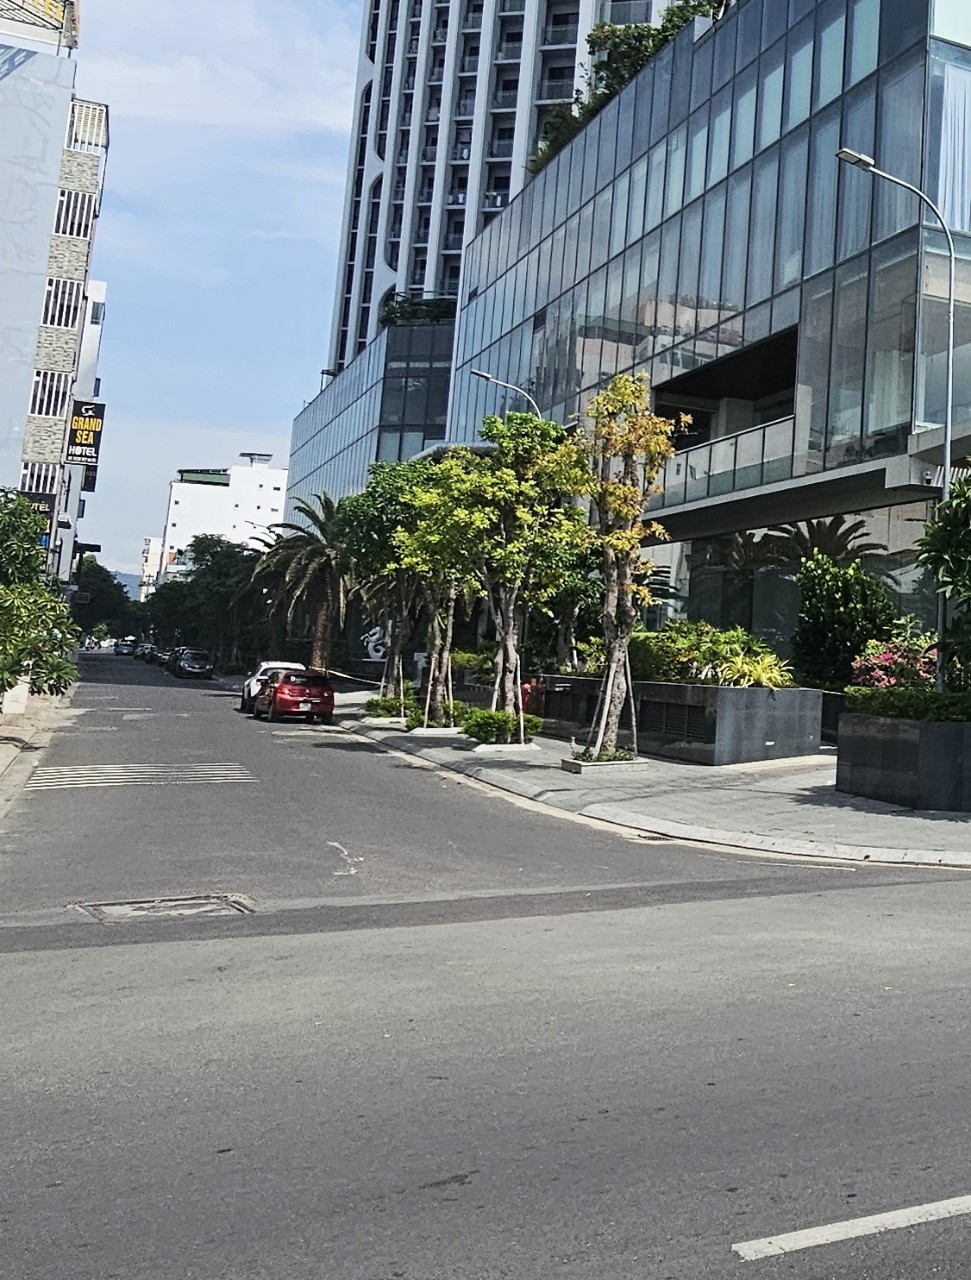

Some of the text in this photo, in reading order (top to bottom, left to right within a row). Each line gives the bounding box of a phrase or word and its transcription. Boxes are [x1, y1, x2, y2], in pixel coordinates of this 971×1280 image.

[72, 416, 103, 432] GRAND
[75, 430, 94, 445] SEA
[68, 445, 98, 457] HOTEL
